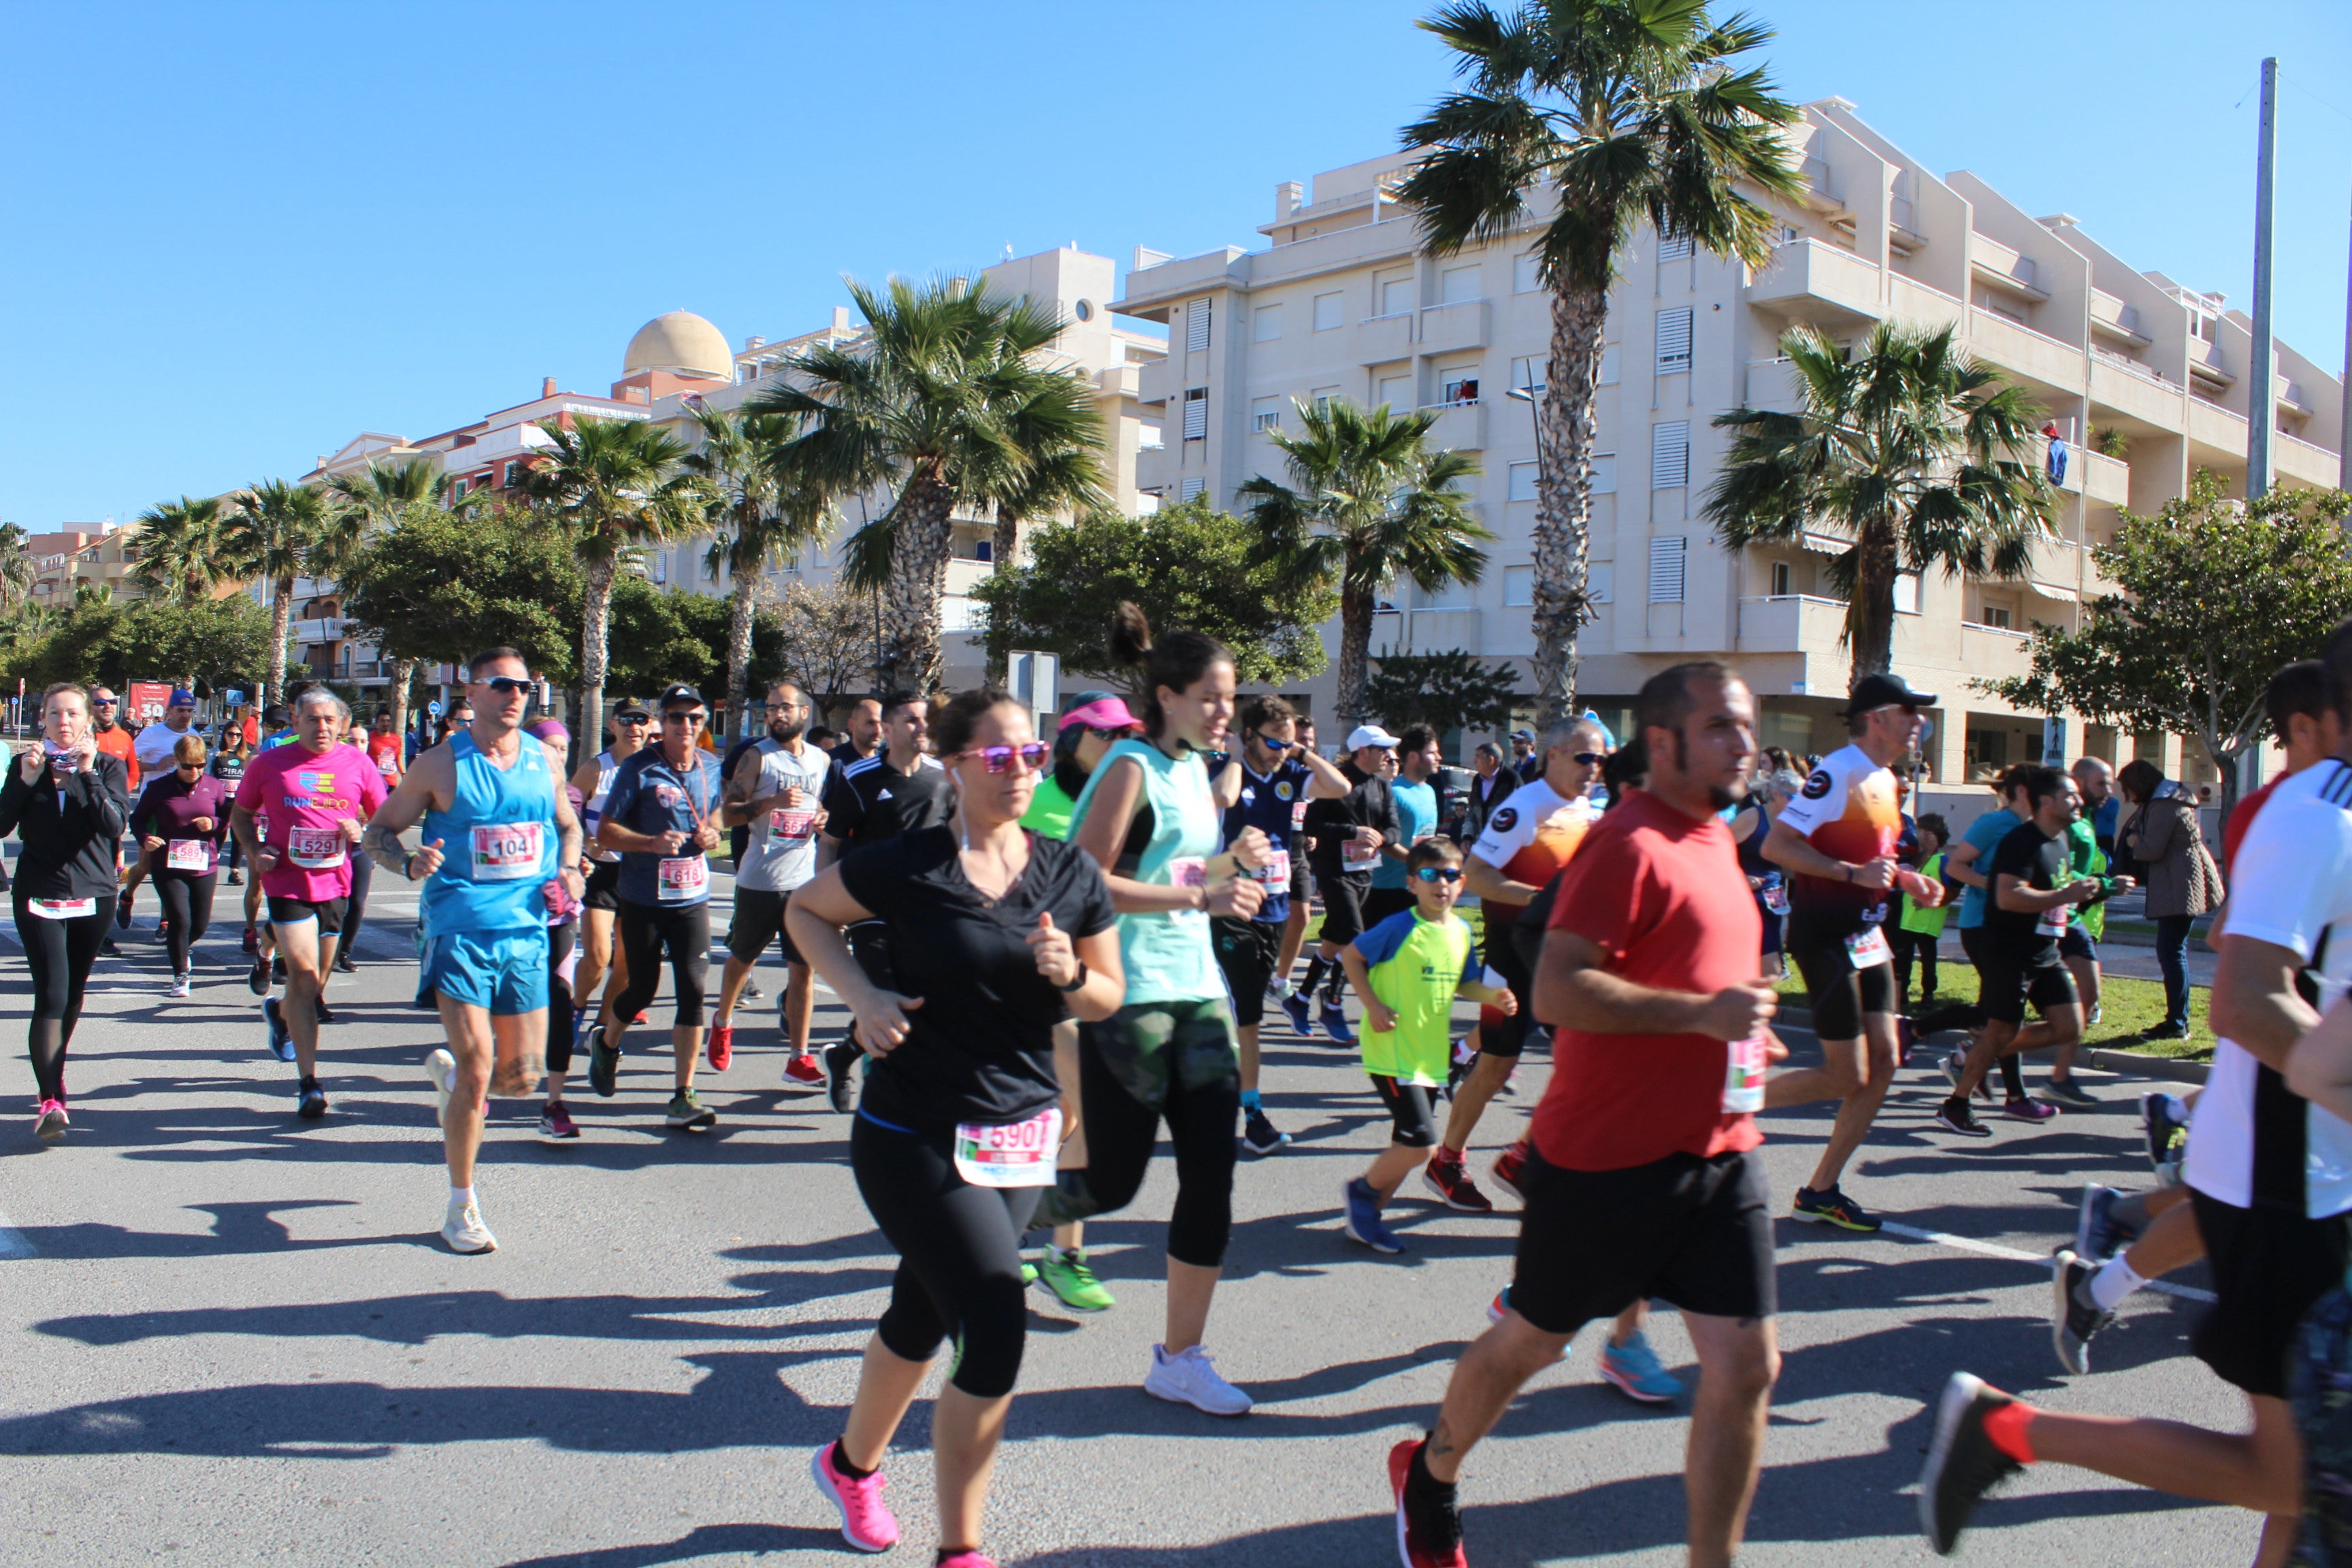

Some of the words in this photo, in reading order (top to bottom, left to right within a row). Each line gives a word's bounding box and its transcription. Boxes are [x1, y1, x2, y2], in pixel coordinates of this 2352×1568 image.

[140, 704, 163, 717] 30
[283, 796, 348, 809] RUNEJIDO
[304, 840, 332, 852] 529
[495, 838, 527, 855] 104
[180, 848, 199, 858] 589
[674, 869, 699, 882] 618
[991, 1122, 1035, 1148] 590
